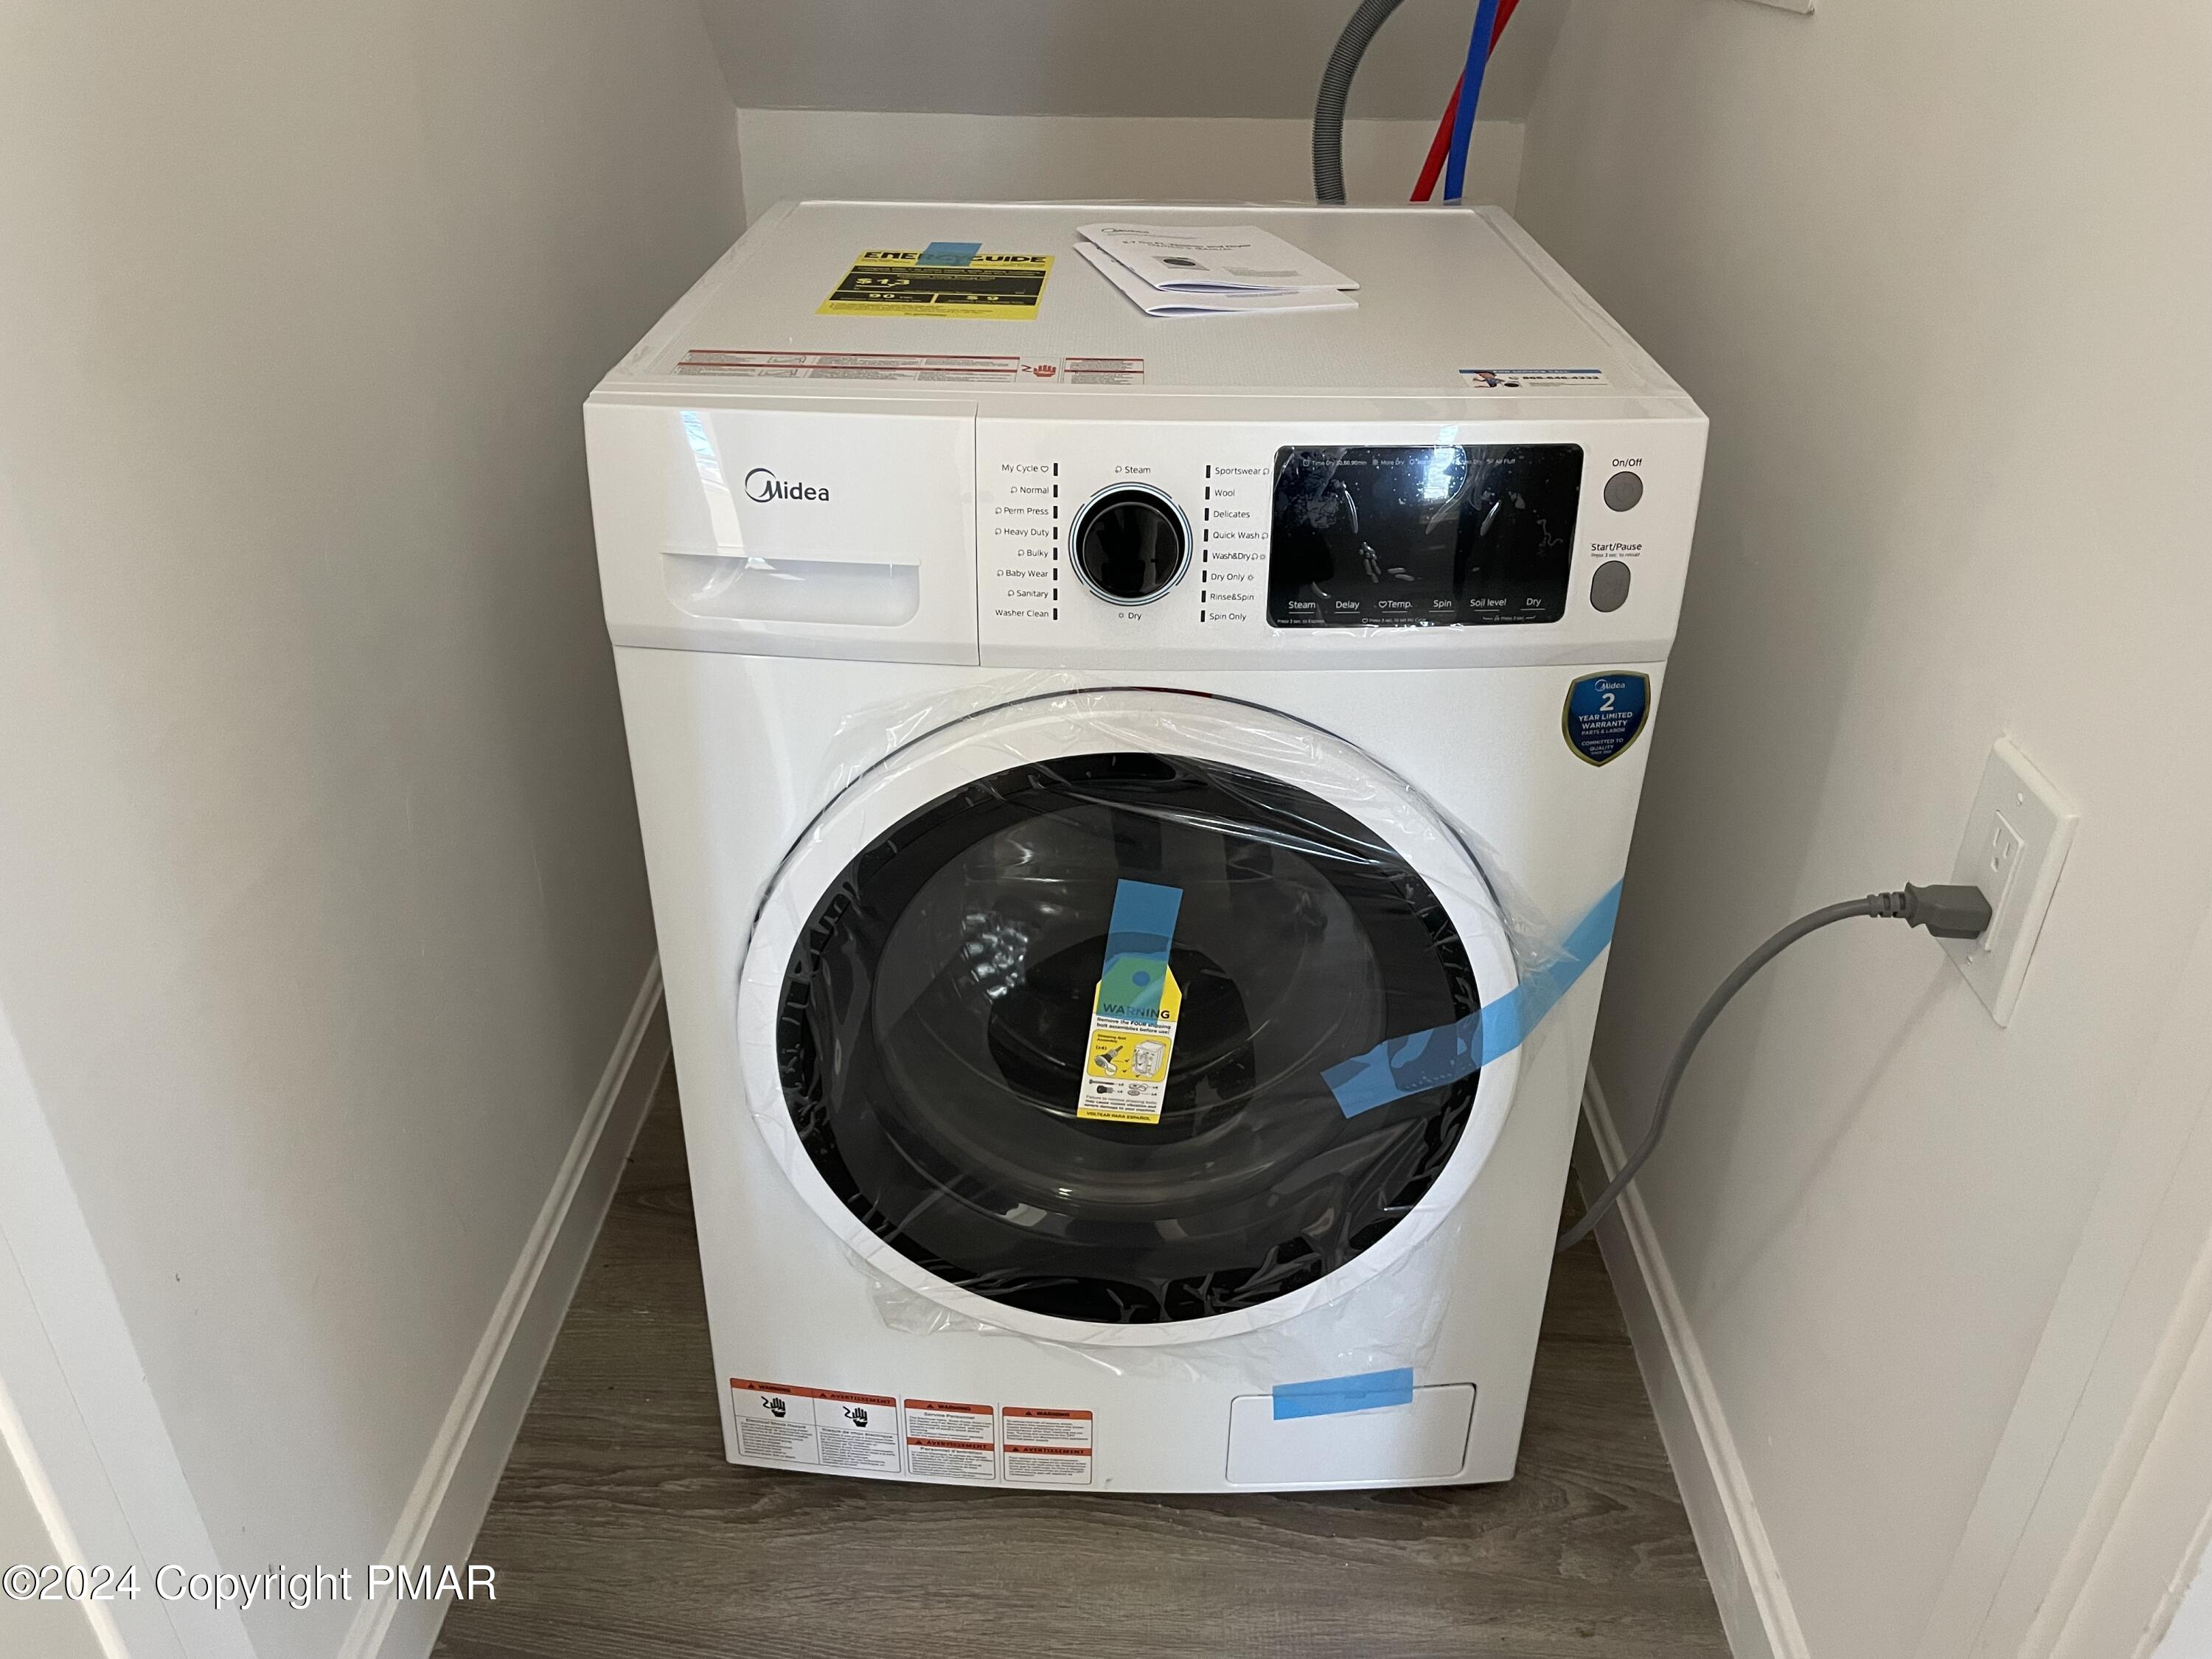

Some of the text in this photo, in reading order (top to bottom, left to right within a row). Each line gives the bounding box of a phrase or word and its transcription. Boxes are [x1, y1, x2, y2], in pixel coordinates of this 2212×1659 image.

[1612, 458, 1643, 467] On/Off
[1002, 464, 1038, 473] My Cycle
[1124, 465, 1151, 473] Steam
[1214, 467, 1261, 476] Sportswear
[745, 467, 830, 503] Midea
[1027, 507, 1048, 515] Press
[1004, 528, 1049, 537] Heavy Duty
[1213, 531, 1236, 539] Quick
[1591, 543, 1643, 552] Start/Pause
[1026, 549, 1048, 558] Bulky
[1212, 552, 1251, 561] Wash&Dry
[1006, 569, 1026, 579] Baby
[1211, 573, 1245, 582] Dry Only
[1016, 590, 1048, 599] Sanitary
[1210, 593, 1254, 602] Rinse&Spin
[1288, 600, 1316, 609] Steam
[1335, 600, 1360, 611] Delay
[1387, 600, 1413, 610] Temp.
[1433, 599, 1452, 609] Spin
[1470, 598, 1507, 608] Soil level
[1526, 597, 1542, 607] Dry
[1128, 612, 1142, 621] Dry
[1209, 613, 1246, 622] Spin Only
[1595, 679, 1626, 692] Midea
[1599, 692, 1615, 712] 2
[1579, 712, 1632, 722] YEAR LIMITED
[1582, 720, 1628, 729] WARRANTY
[1103, 1004, 1170, 1019] WARNING
